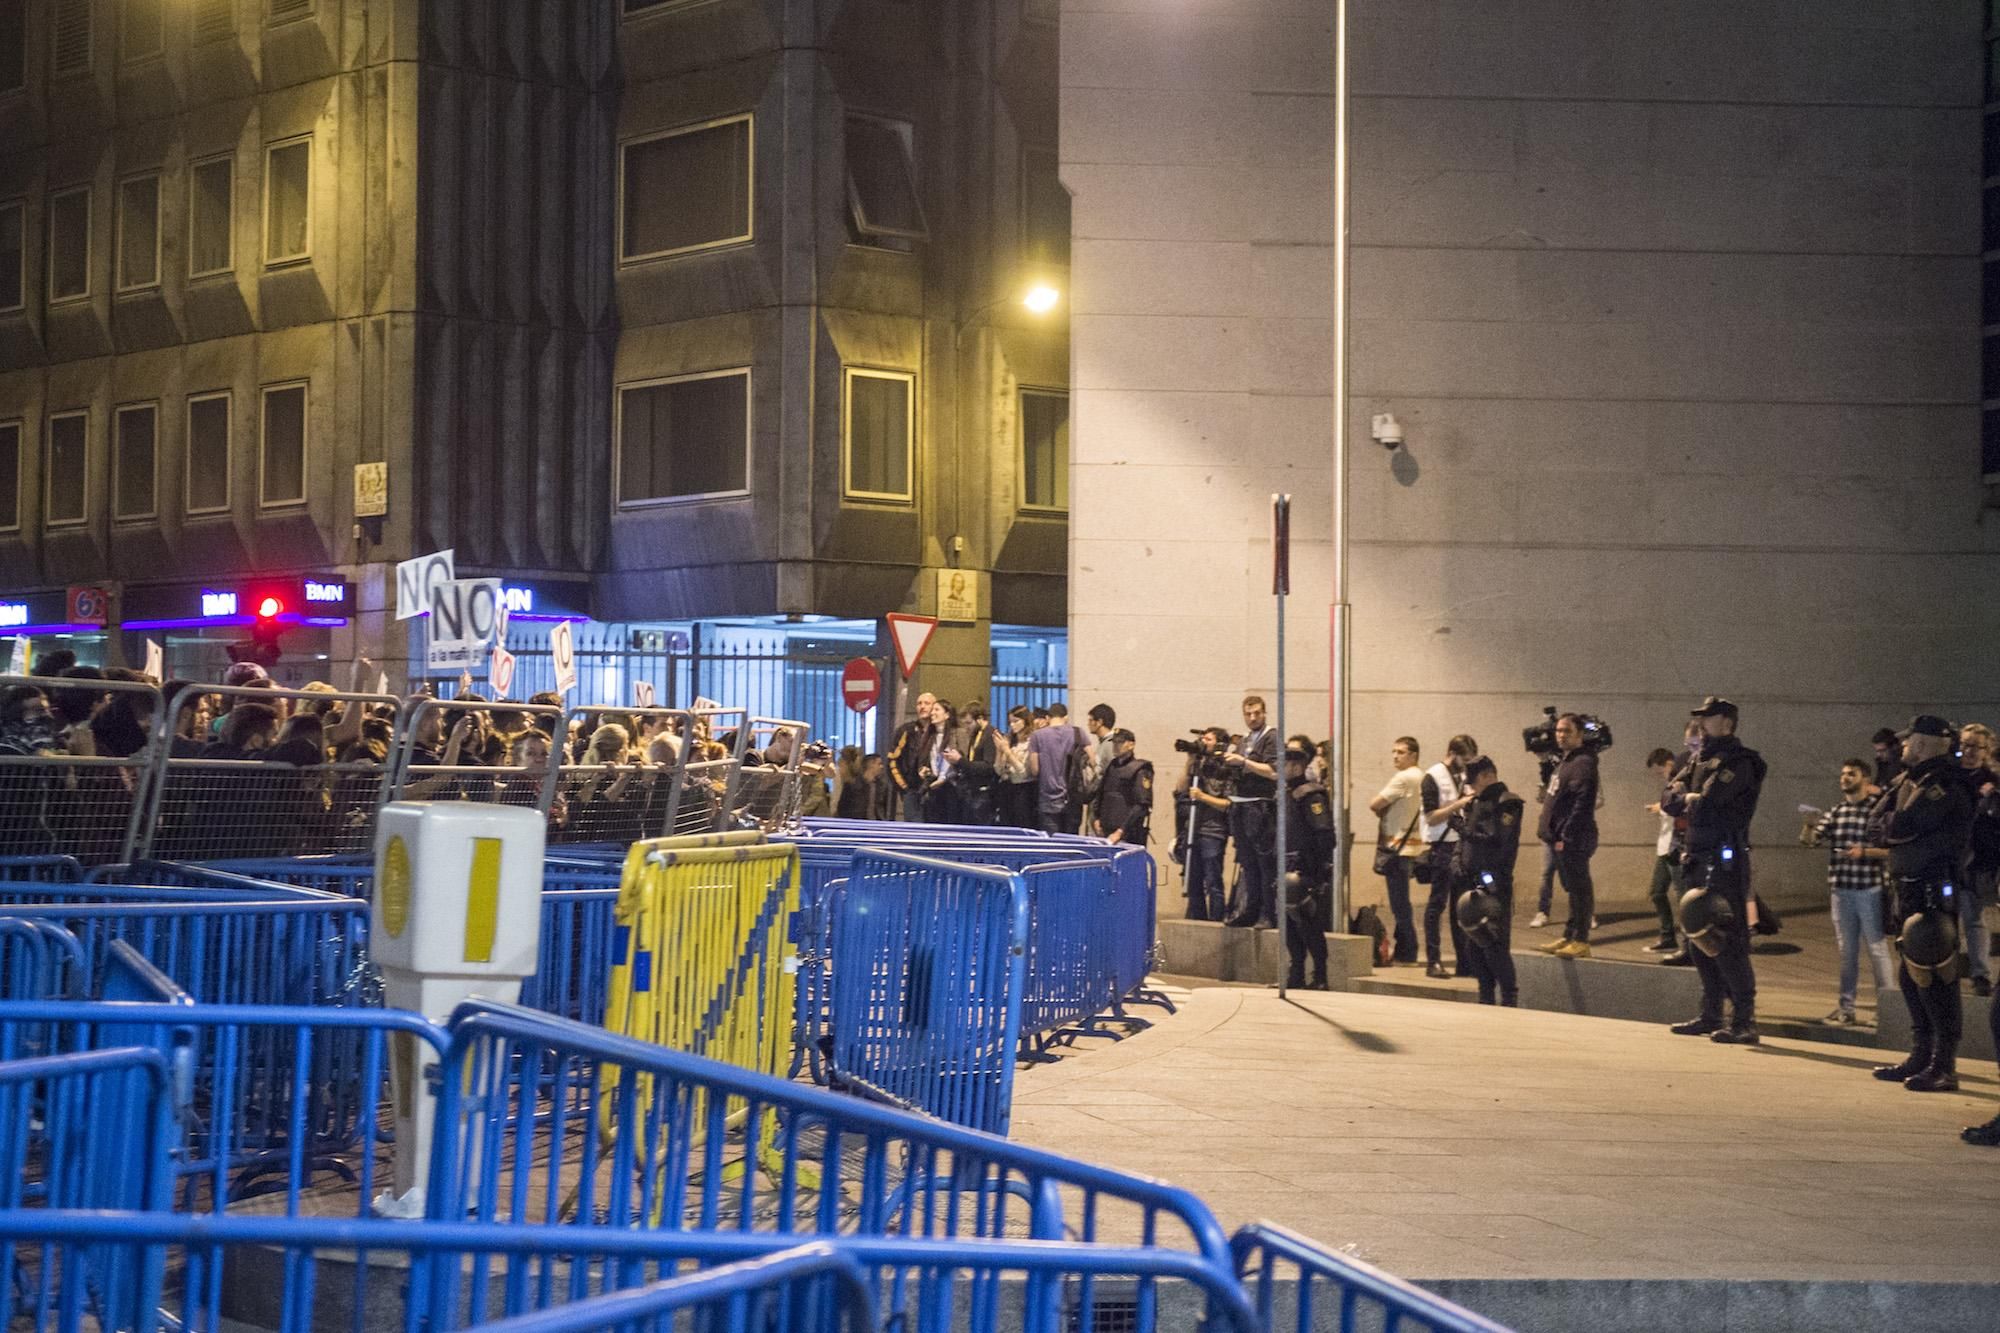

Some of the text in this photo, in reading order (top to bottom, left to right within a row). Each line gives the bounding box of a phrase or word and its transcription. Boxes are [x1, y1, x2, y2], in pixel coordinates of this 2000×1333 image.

[305, 584, 343, 601] BMN
[400, 556, 450, 614] NO
[495, 588, 531, 611] MN
[434, 584, 495, 641] NO
